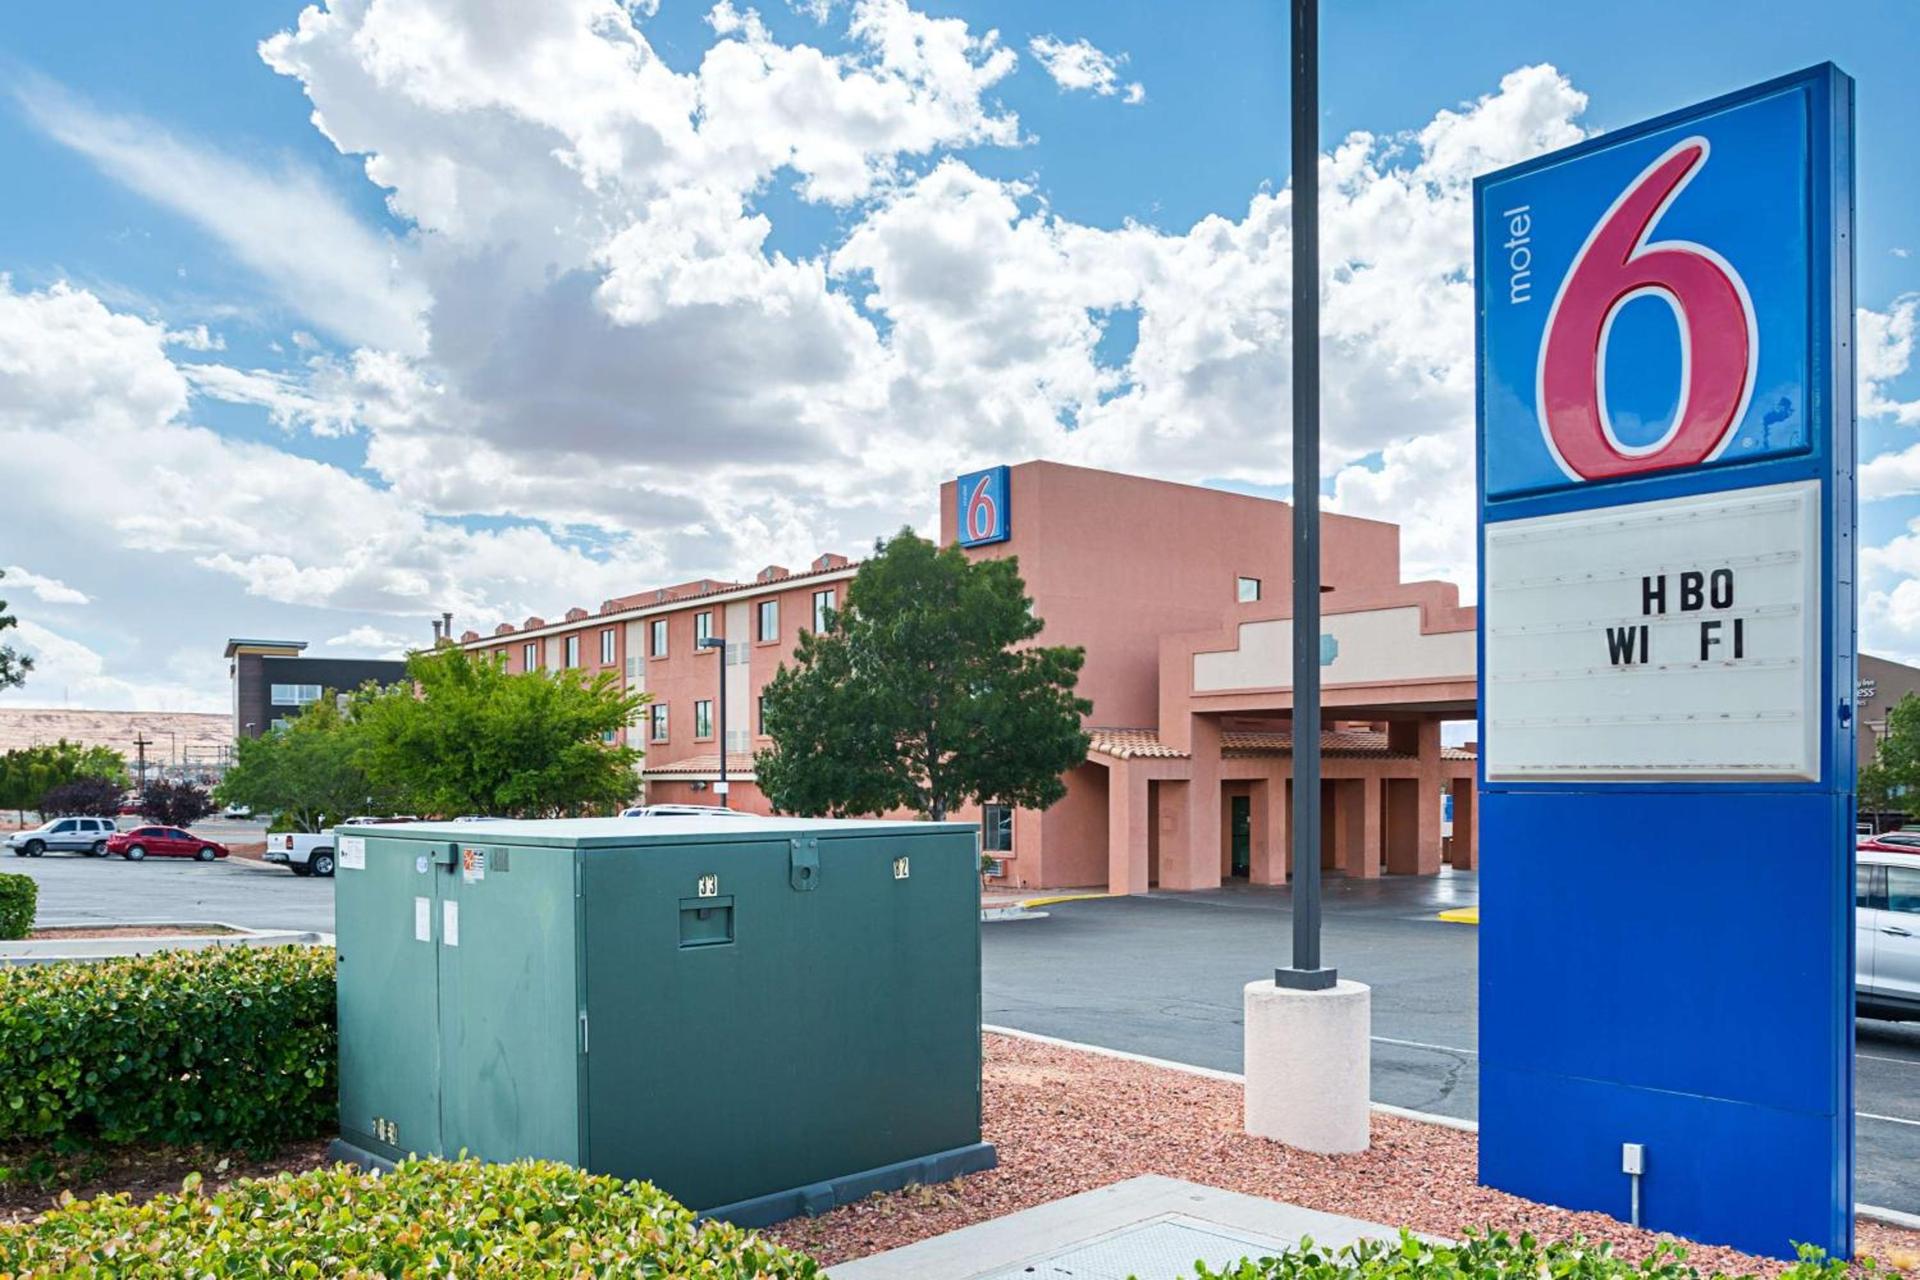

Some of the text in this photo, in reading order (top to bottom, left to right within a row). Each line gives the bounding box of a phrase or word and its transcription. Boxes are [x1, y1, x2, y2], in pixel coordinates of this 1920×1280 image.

[1503, 205, 1531, 304] motel
[1536, 135, 1760, 482] 6
[967, 475, 997, 541] 6
[1642, 568, 1734, 615] HBO
[1606, 618, 1744, 665] WI FI
